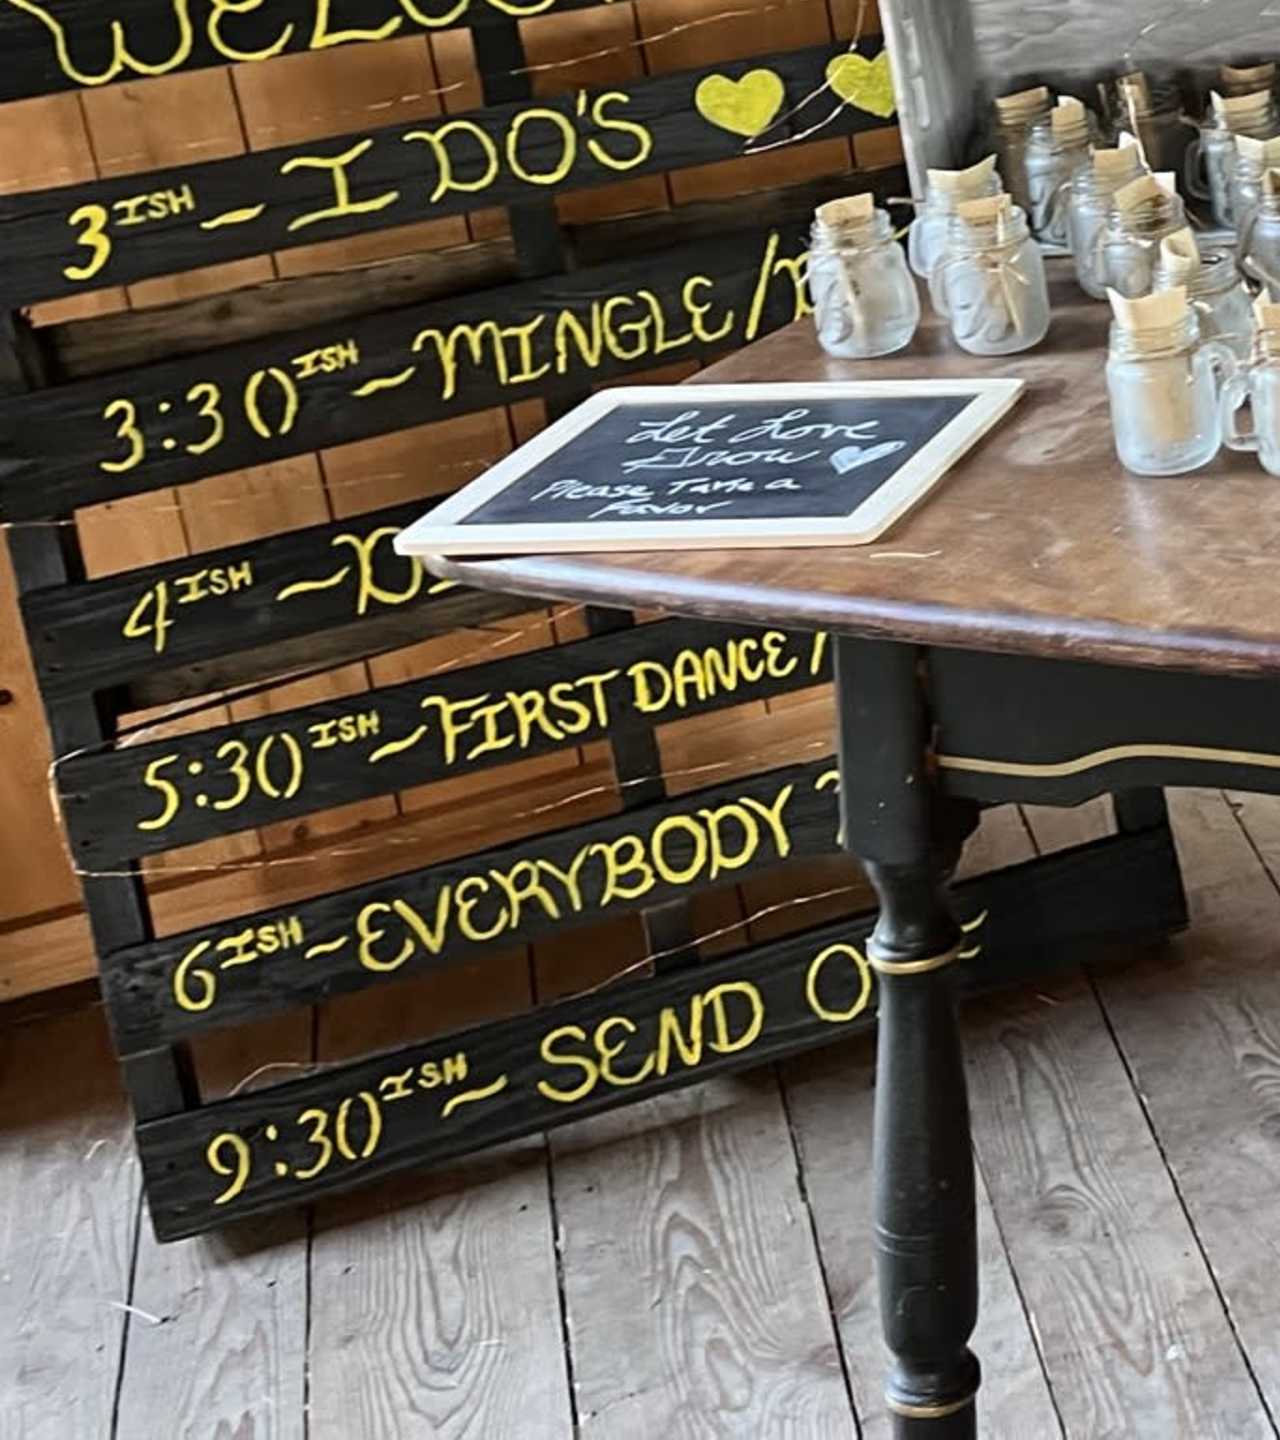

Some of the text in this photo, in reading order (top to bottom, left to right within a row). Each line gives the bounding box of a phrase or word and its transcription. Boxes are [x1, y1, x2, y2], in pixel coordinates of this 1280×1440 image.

[625, 410, 736, 444] Let
[531, 477, 656, 502] Please
[420, 670, 620, 765] FIRST
[357, 784, 793, 972] EVERYBODY
[537, 980, 765, 1103] SEND
